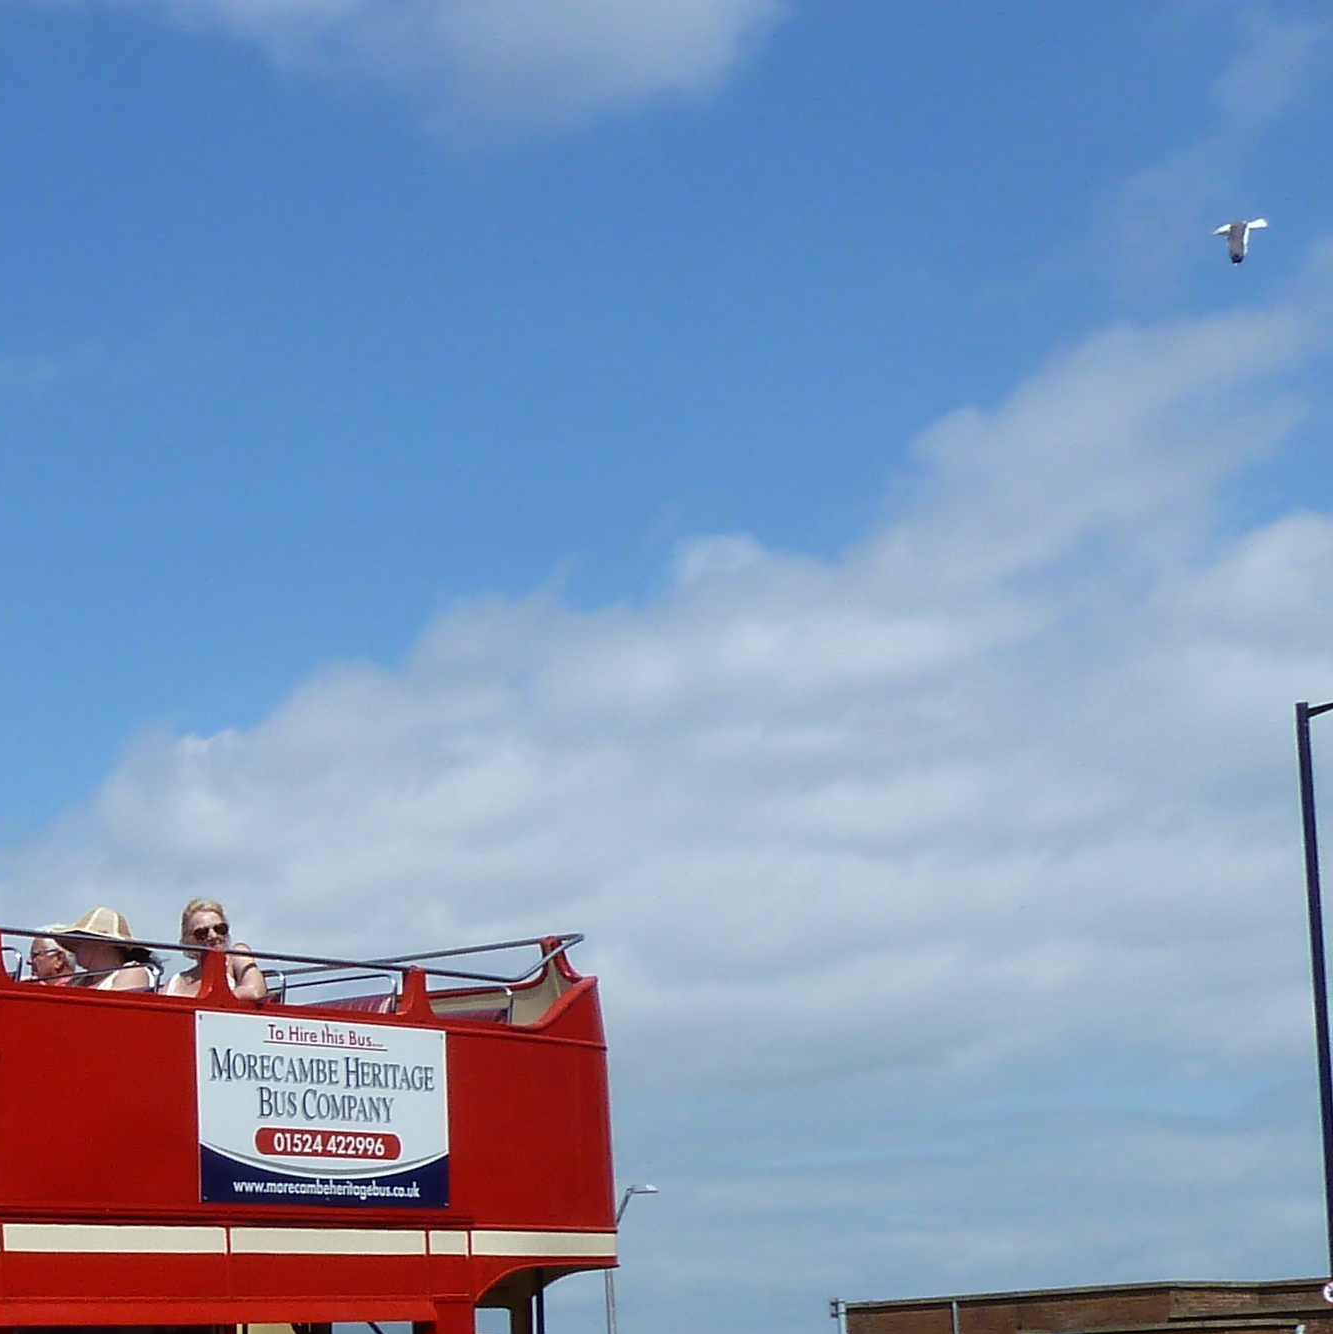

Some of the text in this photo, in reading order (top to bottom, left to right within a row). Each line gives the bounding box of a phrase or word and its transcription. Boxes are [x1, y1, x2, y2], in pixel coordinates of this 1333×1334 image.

[268, 1024, 284, 1041] To
[289, 1026, 317, 1043] Hire
[322, 1024, 345, 1045] this
[210, 1047, 435, 1091] MORECAMBE HERITAGE
[257, 1086, 394, 1124] BUS COMPANY
[272, 1132, 385, 1156] 01524 422996
[233, 1178, 421, 1200] www.morecambeheritagebus.co.uk
